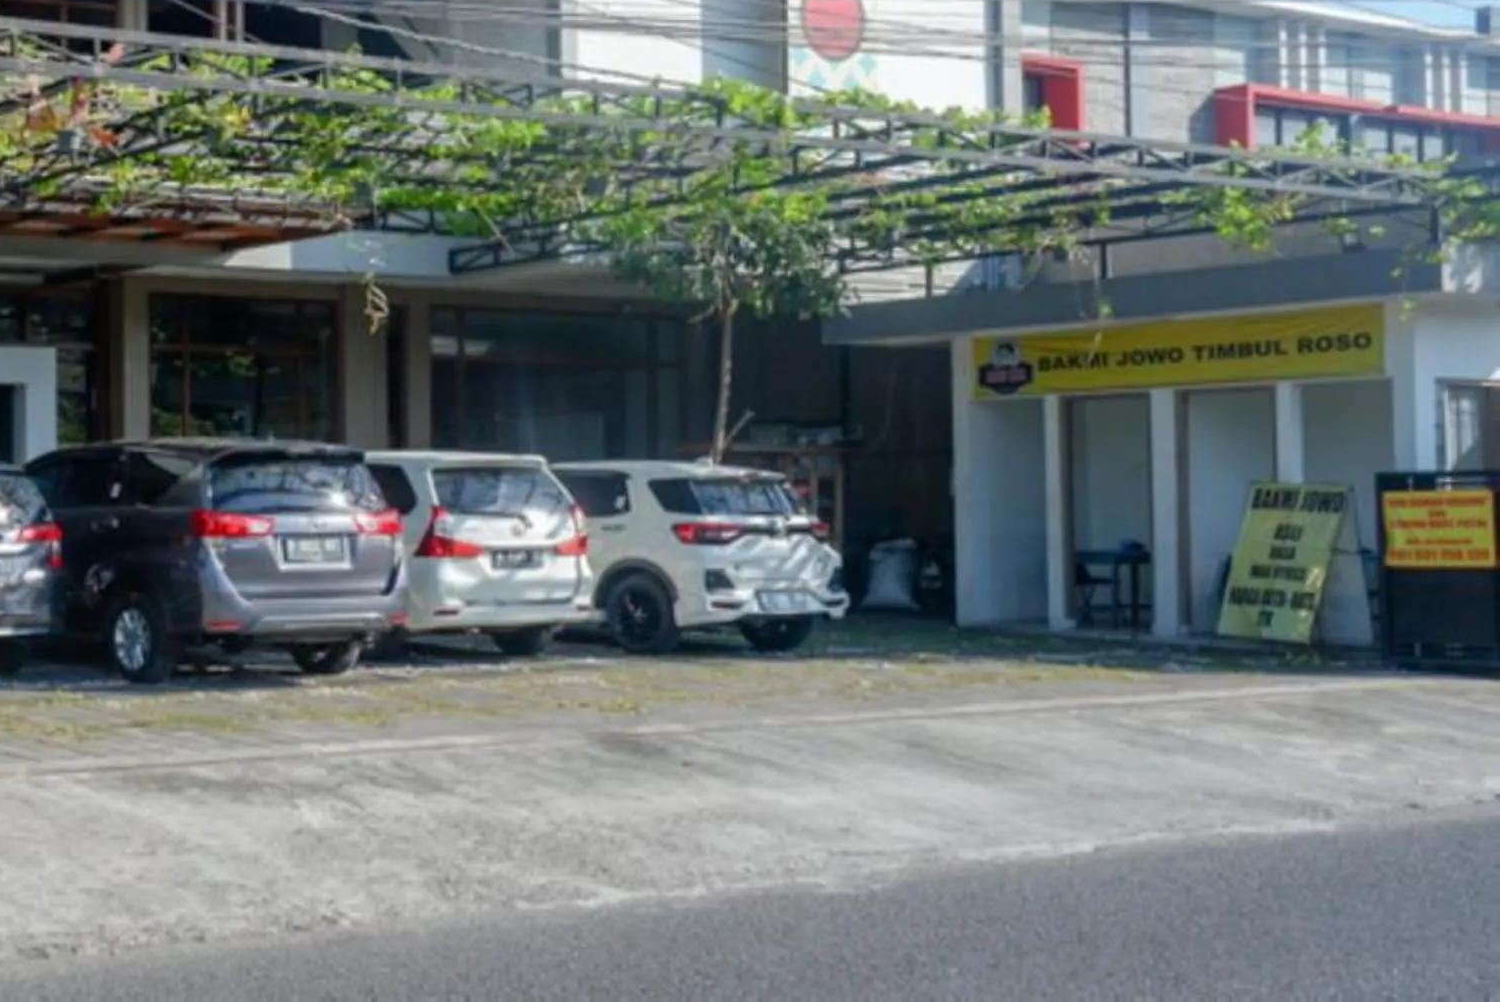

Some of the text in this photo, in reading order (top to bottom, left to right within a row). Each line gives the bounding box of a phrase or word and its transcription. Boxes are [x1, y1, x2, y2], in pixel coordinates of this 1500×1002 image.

[1037, 331, 1373, 372] BAKMI JOWO TIMBUL ROSO
